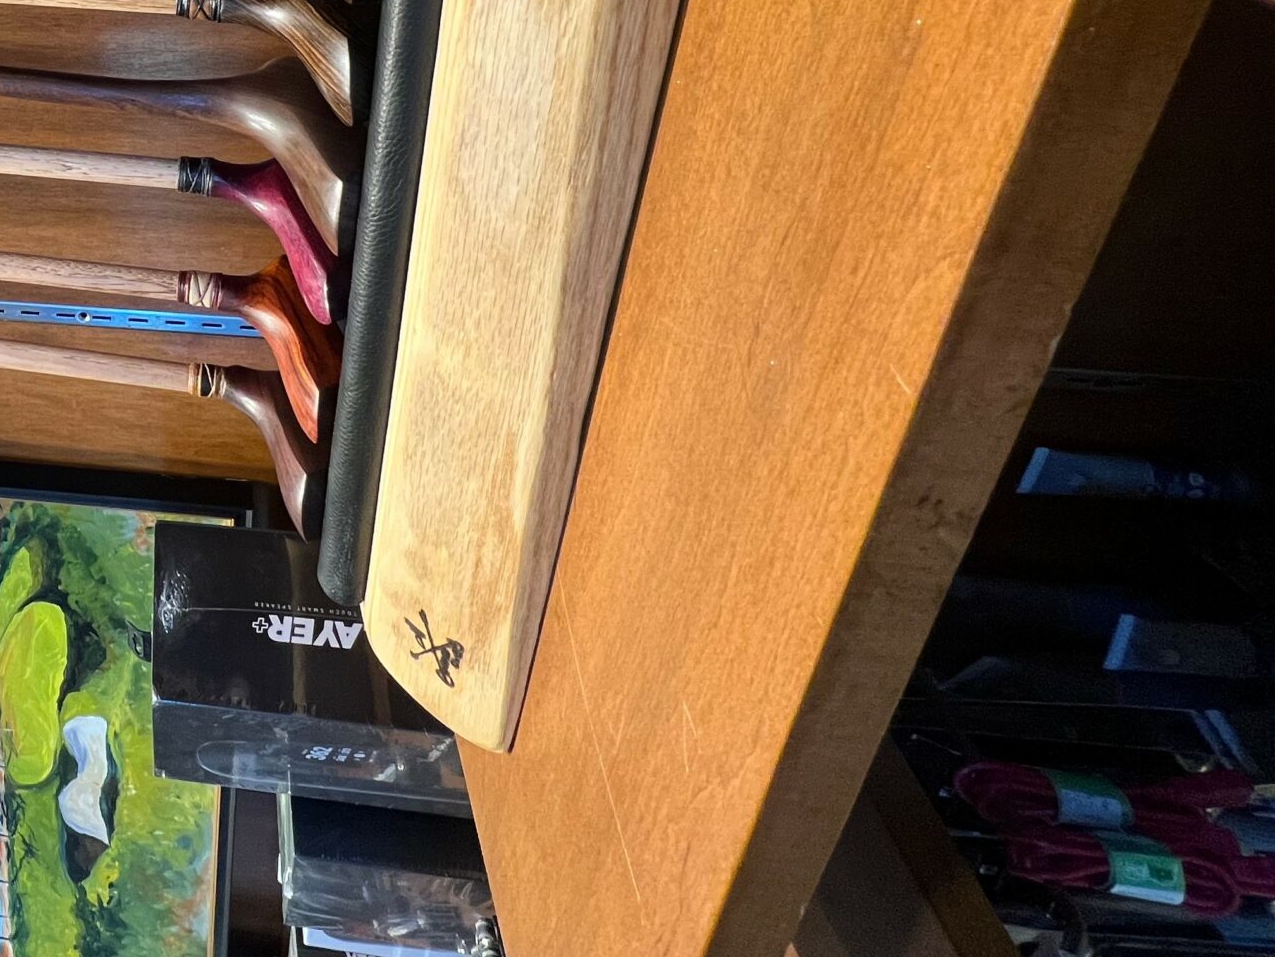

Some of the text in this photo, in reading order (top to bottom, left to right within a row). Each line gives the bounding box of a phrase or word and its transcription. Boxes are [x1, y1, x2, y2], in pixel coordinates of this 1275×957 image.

[254, 601, 357, 617] TOUCH SMART SPEAKER
